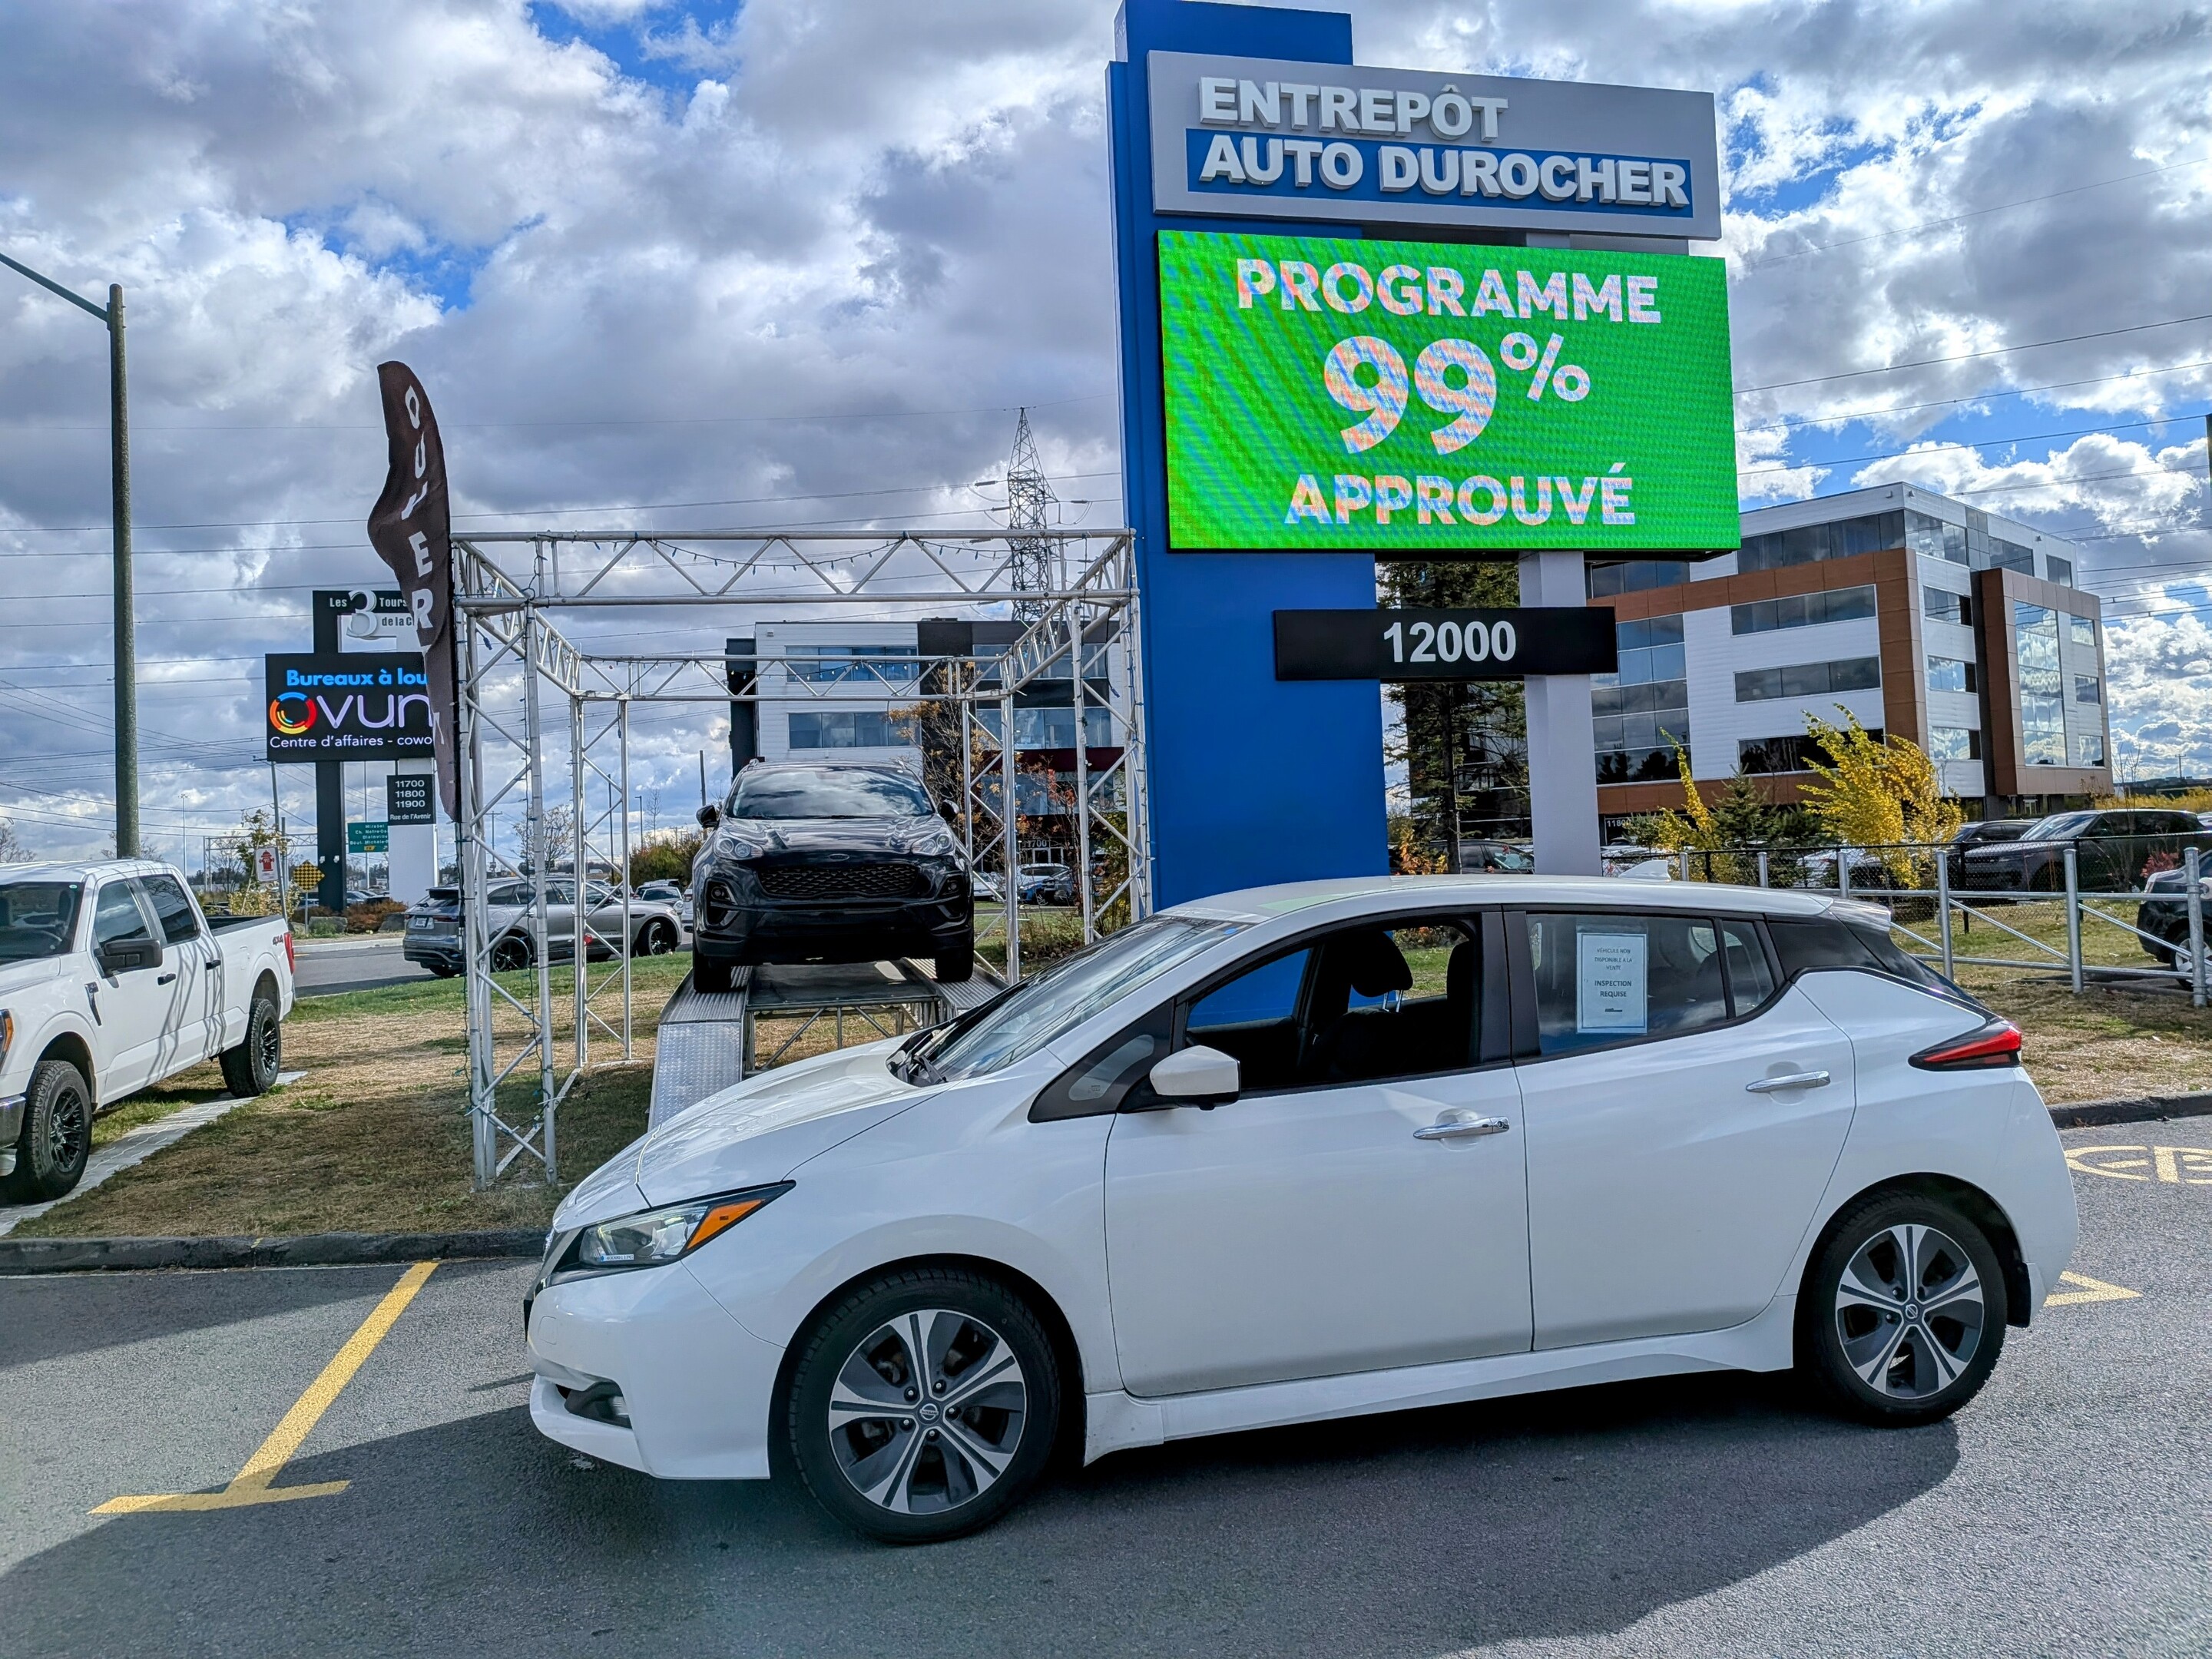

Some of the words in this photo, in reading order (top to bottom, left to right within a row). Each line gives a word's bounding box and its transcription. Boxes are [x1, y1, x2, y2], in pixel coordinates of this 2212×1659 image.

[1200, 77, 1509, 142] ENTREPÔT
[1198, 134, 1363, 190] AUTO
[1379, 145, 1690, 207] DUROCHER
[1237, 259, 1661, 323] PROGRAMME
[1324, 333, 1590, 455] 99%
[1284, 462, 1635, 525] APPROUVÉ
[329, 598, 347, 607] Les
[346, 589, 378, 640] 3
[379, 598, 407, 607] Tours
[382, 617, 393, 626] de
[396, 617, 404, 626] la
[1384, 621, 1516, 662] 12000
[286, 670, 373, 687] Bureaux
[379, 669, 392, 685] à
[270, 737, 316, 748] Centre
[321, 735, 383, 747] d'affaires
[395, 780, 425, 788] 11700
